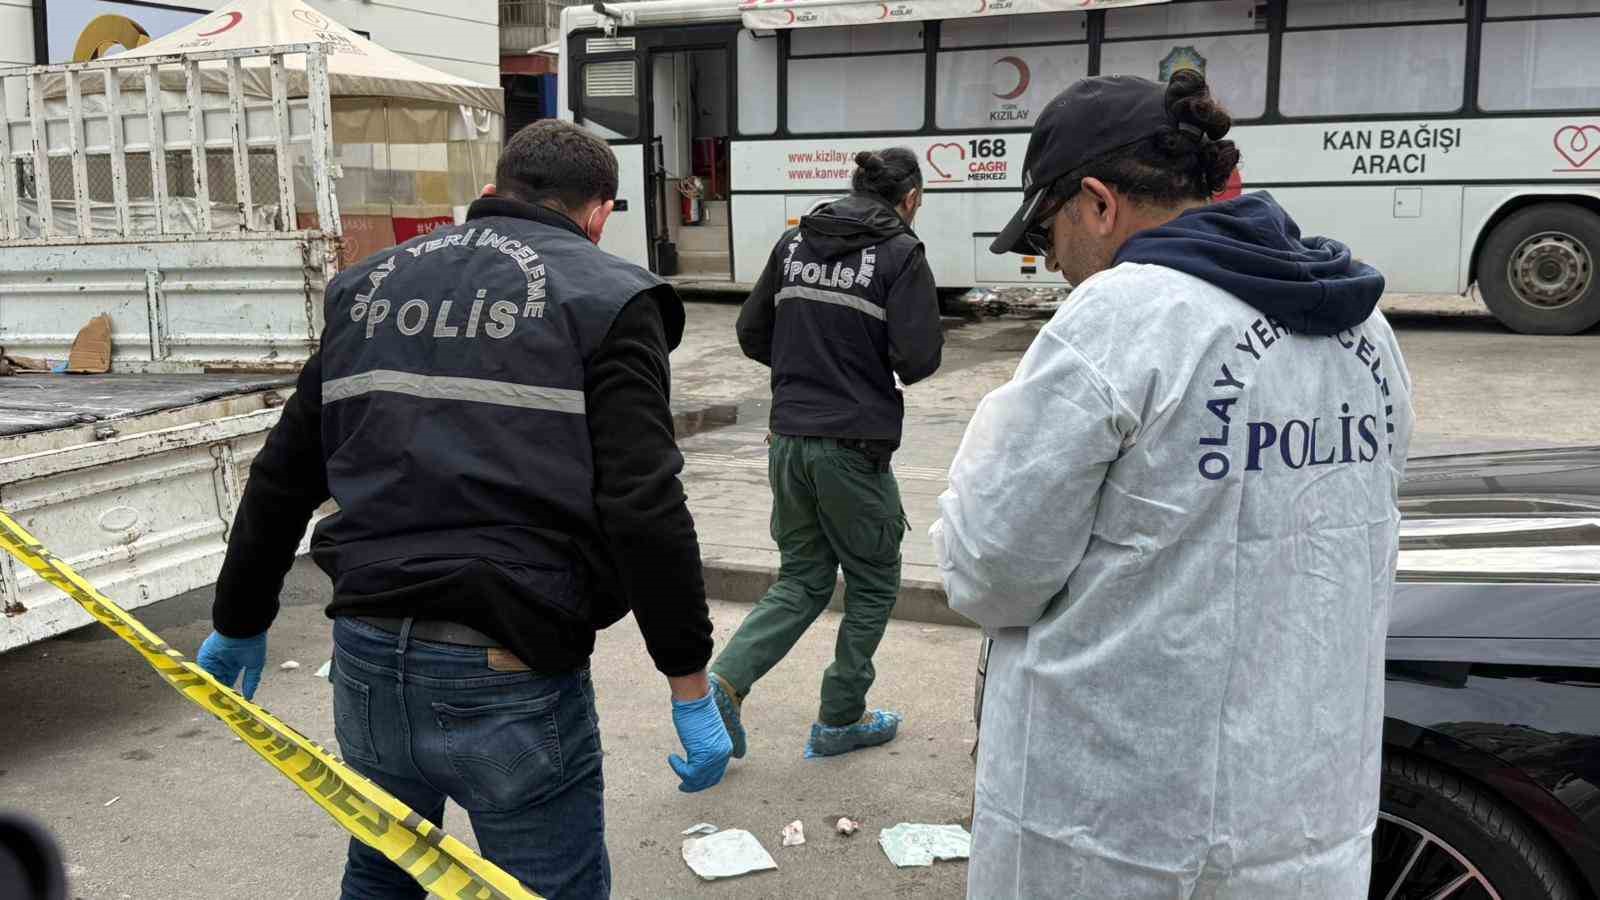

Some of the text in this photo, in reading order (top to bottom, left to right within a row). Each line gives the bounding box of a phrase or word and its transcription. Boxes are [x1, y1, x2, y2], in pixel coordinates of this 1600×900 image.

[989, 110, 1030, 121] KIZILAY
[968, 138, 1007, 158] 168
[1323, 124, 1461, 153] KAN BAĞIŞI
[1352, 153, 1426, 174] ARACI
[351, 255, 396, 322] OLAY
[789, 261, 855, 289] POLİS
[365, 288, 518, 340] POLİS
[1199, 363, 1245, 480] OLAY
[1244, 402, 1379, 471] POLİS
